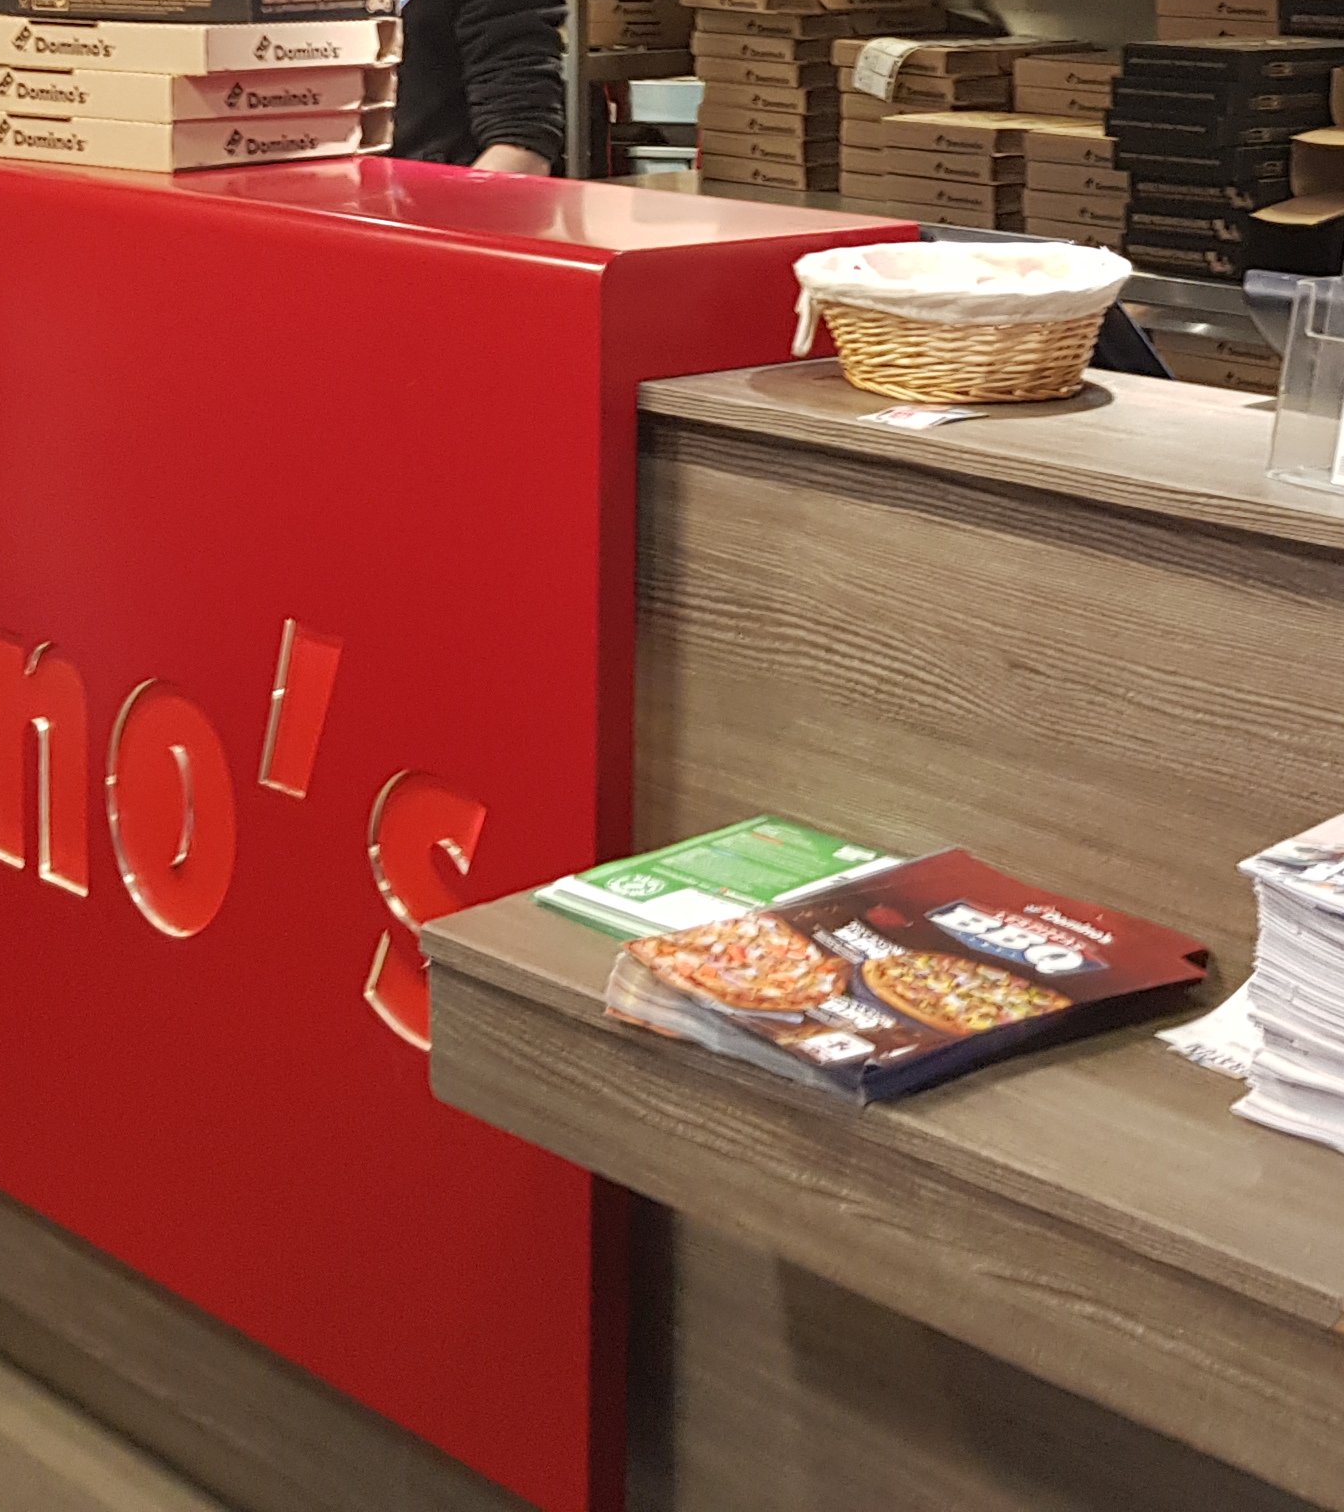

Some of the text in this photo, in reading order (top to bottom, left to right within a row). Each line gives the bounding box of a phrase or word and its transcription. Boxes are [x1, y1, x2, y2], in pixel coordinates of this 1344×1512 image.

[35, 34, 115, 58] Domino's
[274, 41, 342, 62] Domino's
[16, 80, 89, 105] Domino's
[245, 88, 321, 109] Domino's
[13, 128, 86, 153] Domino's
[245, 134, 319, 155] Domino's
[928, 904, 1084, 974] BBQ
